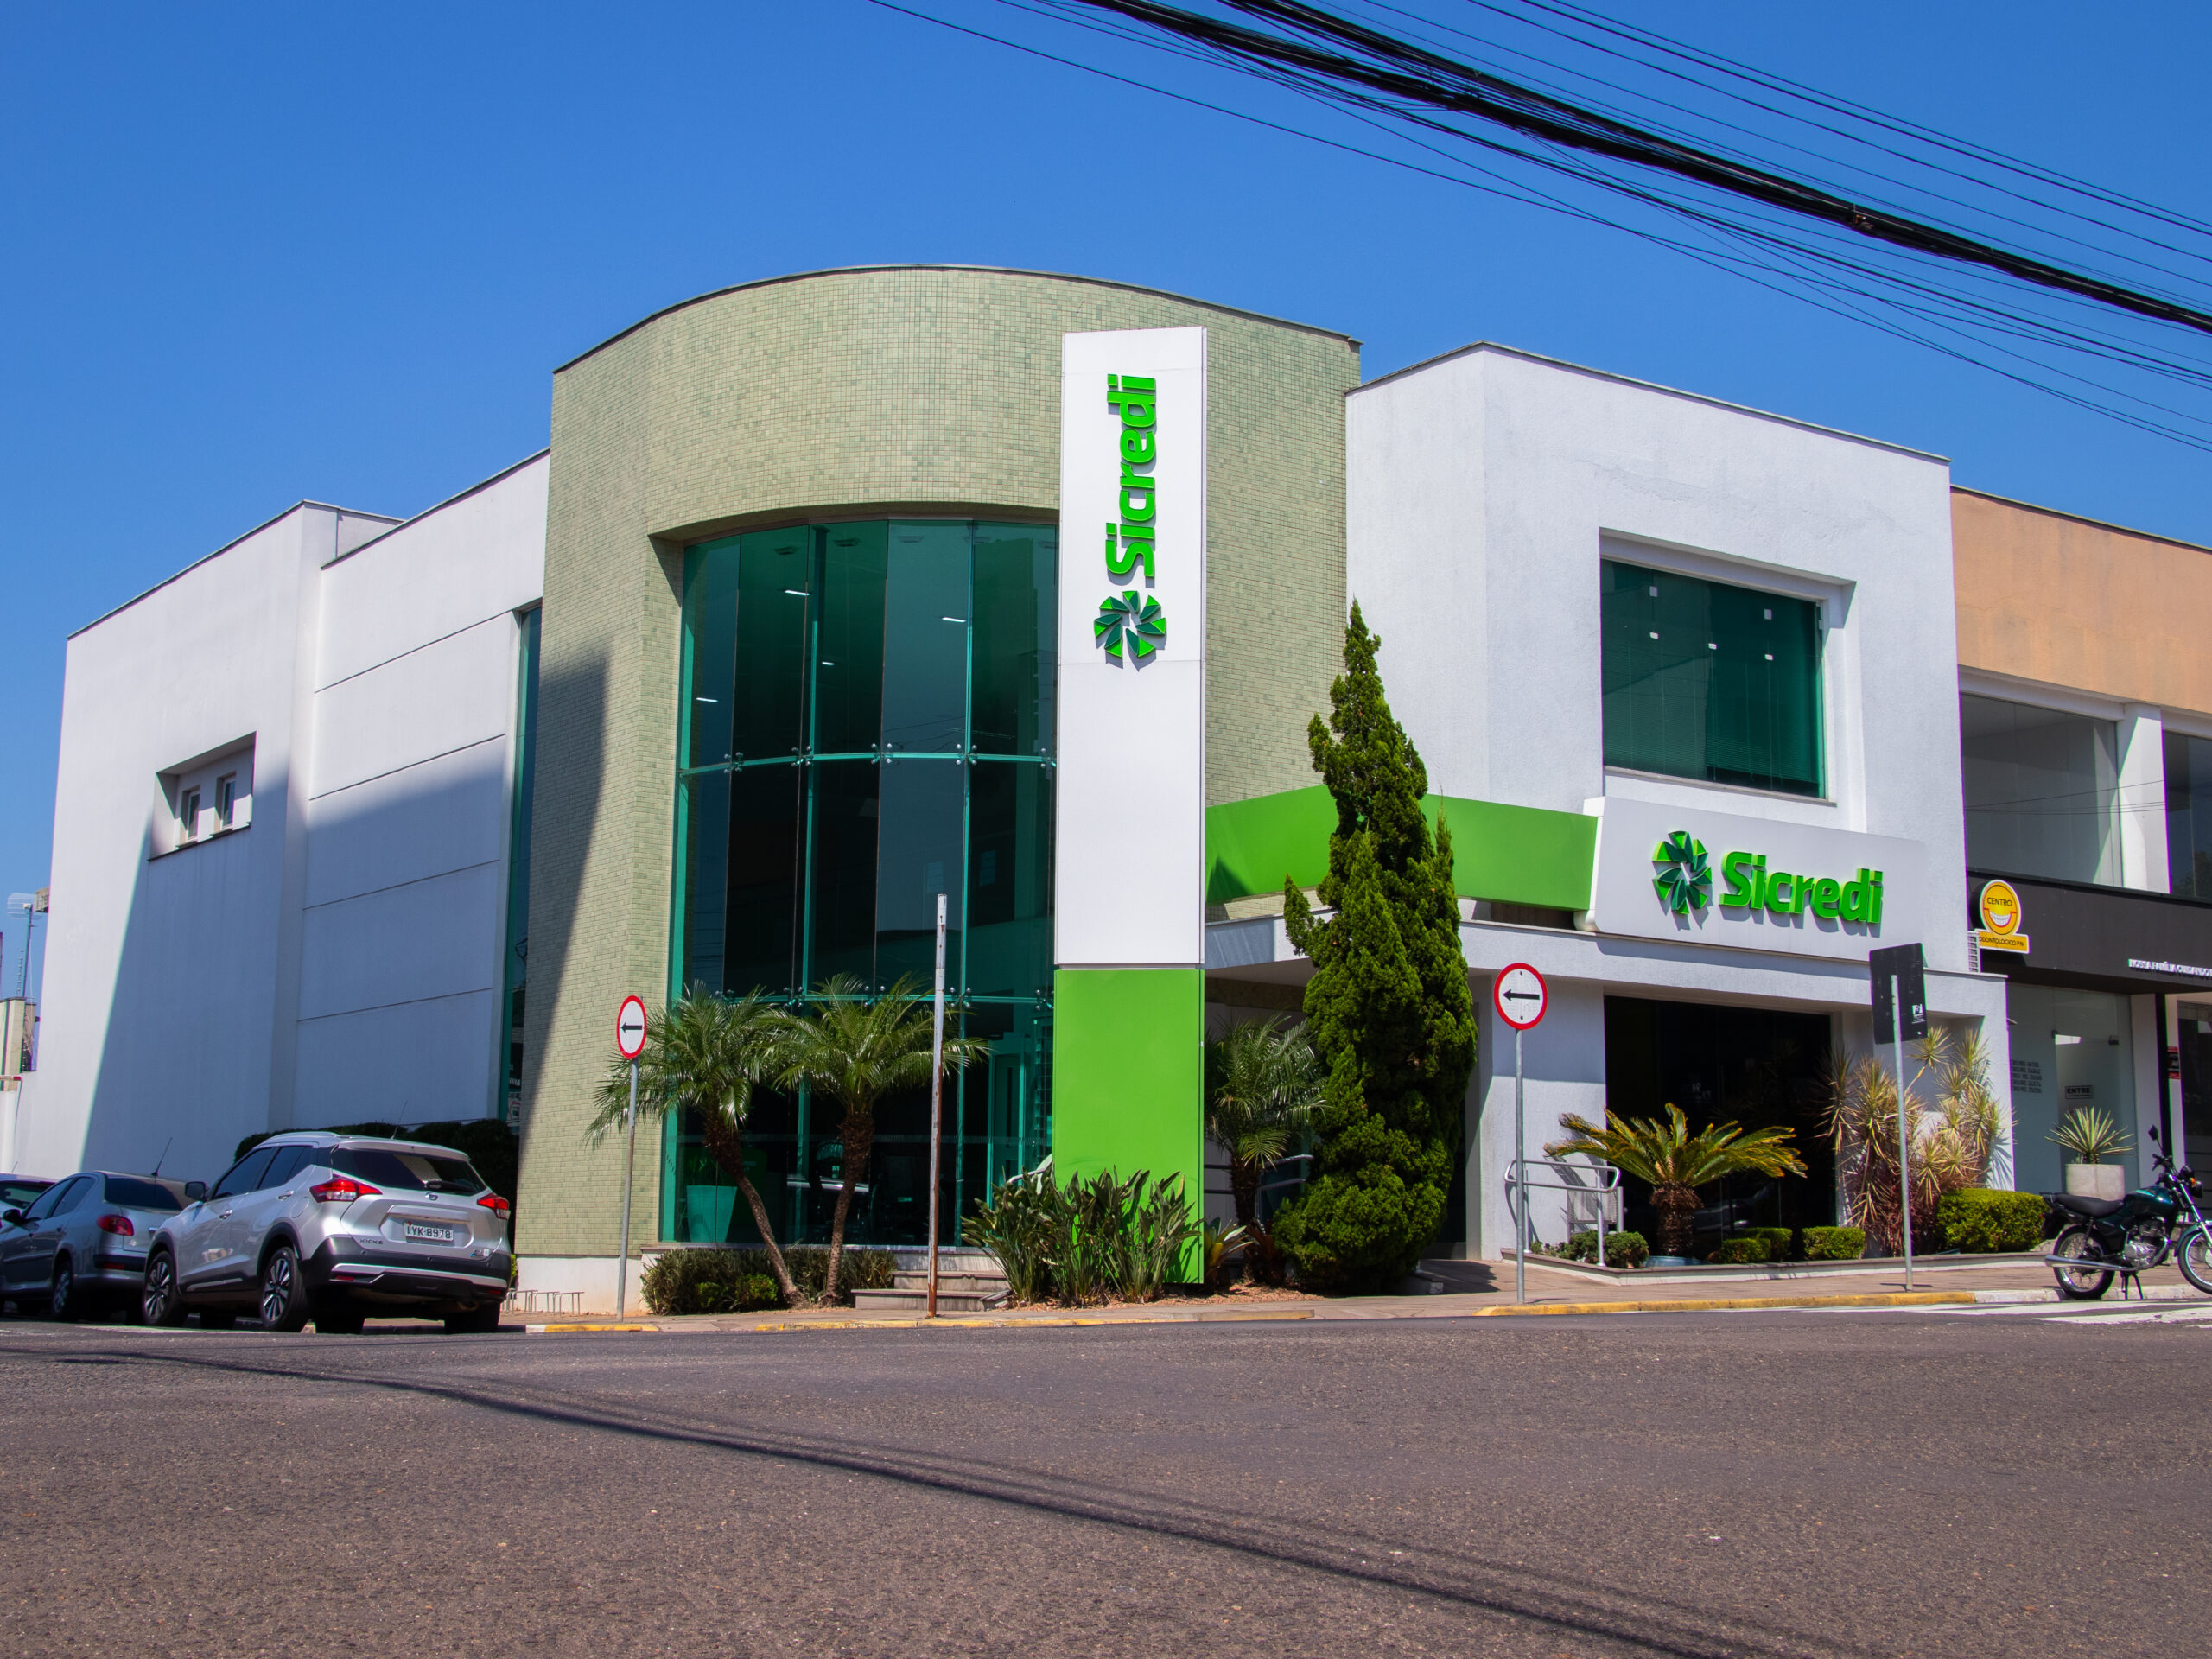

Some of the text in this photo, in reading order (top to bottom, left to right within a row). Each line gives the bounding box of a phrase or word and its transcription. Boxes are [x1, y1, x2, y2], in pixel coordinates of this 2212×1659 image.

[1105, 373, 1156, 577] Sicredi
[1719, 851, 1883, 924] Sicredi
[1986, 897, 2012, 906] CENTRO
